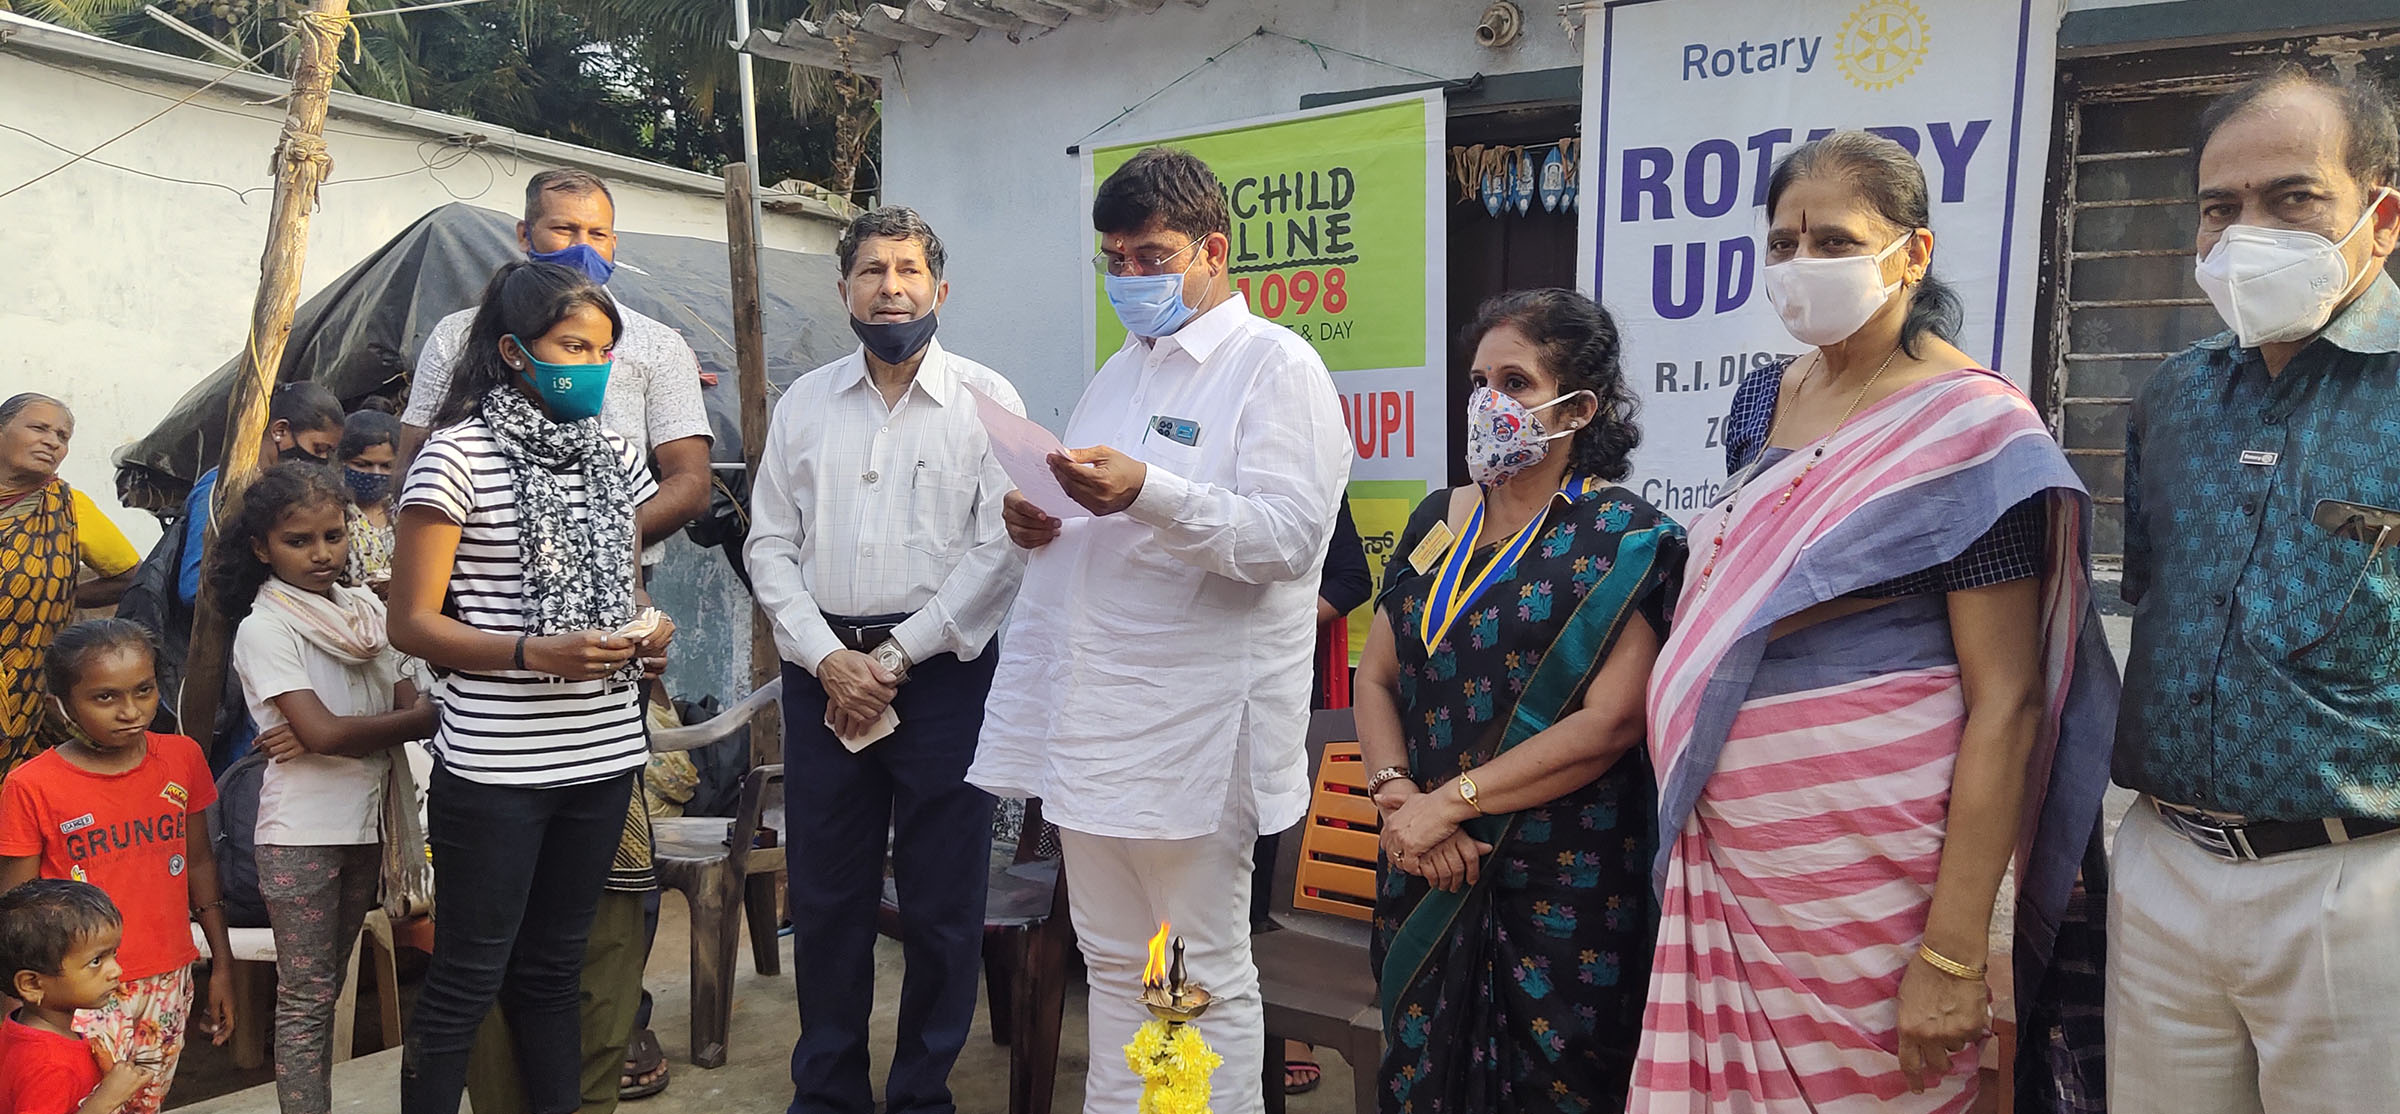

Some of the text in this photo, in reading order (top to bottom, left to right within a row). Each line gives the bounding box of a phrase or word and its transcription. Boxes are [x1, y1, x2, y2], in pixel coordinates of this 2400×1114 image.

[1682, 36, 1822, 81] Rotary
[1231, 167, 1355, 219] CHILD
[1620, 119, 1992, 223] ROTY
[1237, 212, 1354, 262] LINE
[1236, 267, 1348, 319] 1098
[1652, 236, 1756, 320] UD
[1300, 320, 1353, 342] & DAY
[558, 376, 573, 390] 95
[1655, 360, 1709, 393] R.I.
[1642, 478, 1720, 510] Charte
[67, 811, 185, 861] GRUNGE
